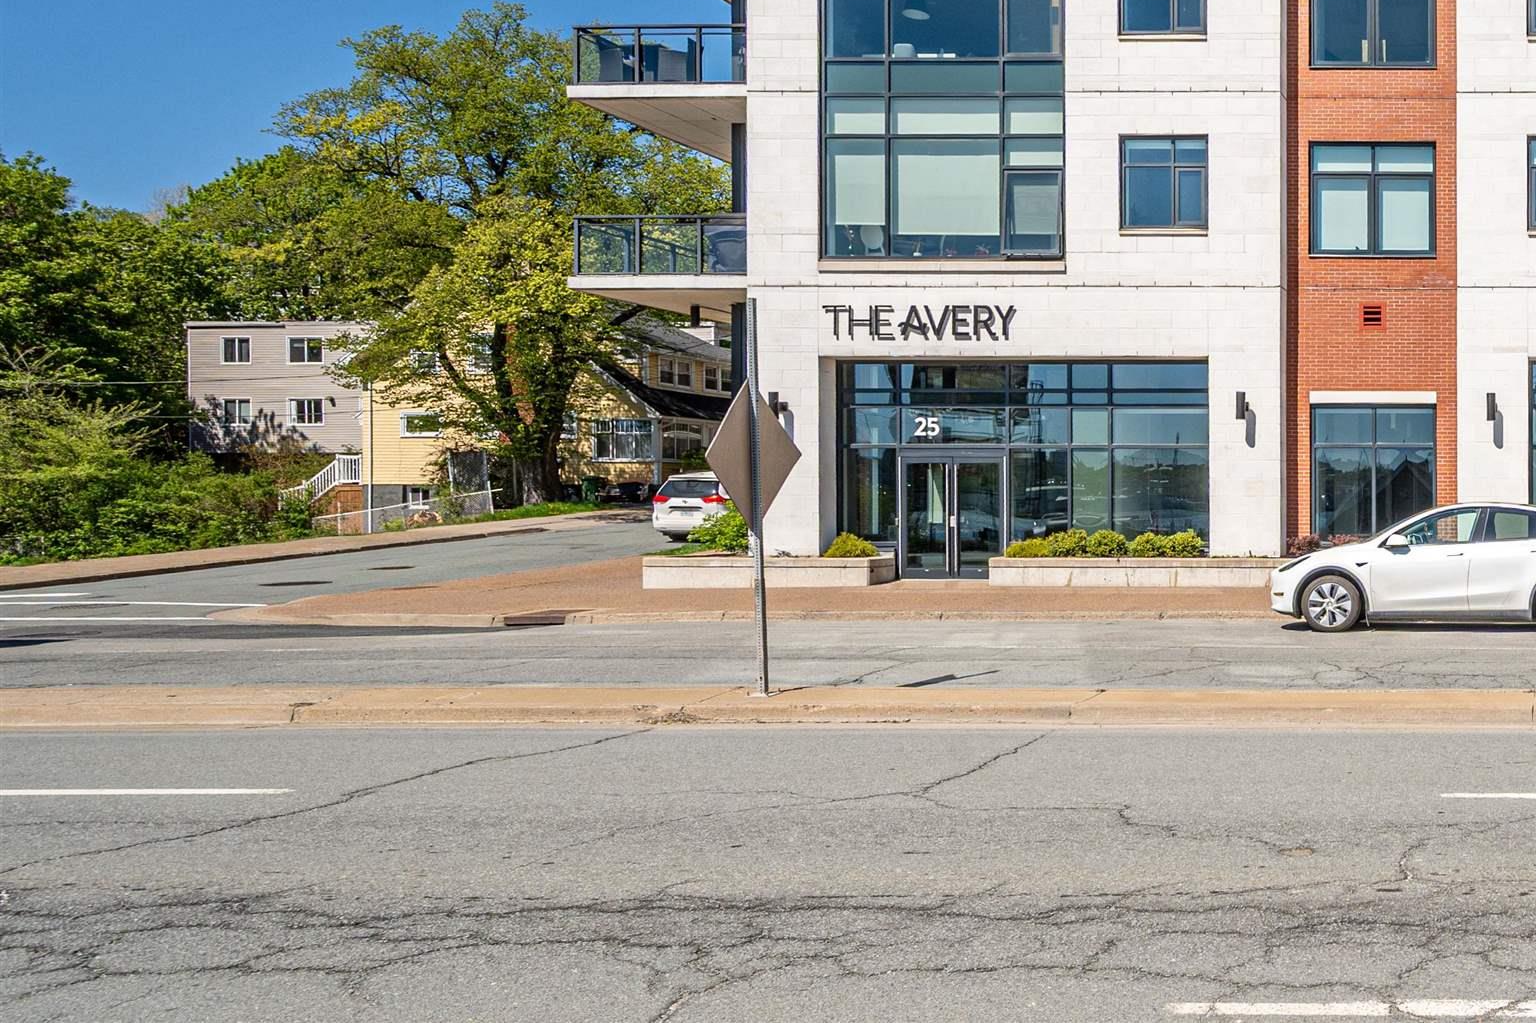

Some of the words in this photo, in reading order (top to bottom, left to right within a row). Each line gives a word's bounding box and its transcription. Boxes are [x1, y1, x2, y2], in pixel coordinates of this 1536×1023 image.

[822, 305, 893, 338] THE
[898, 305, 1014, 338] AVERY
[914, 417, 940, 436] 25
